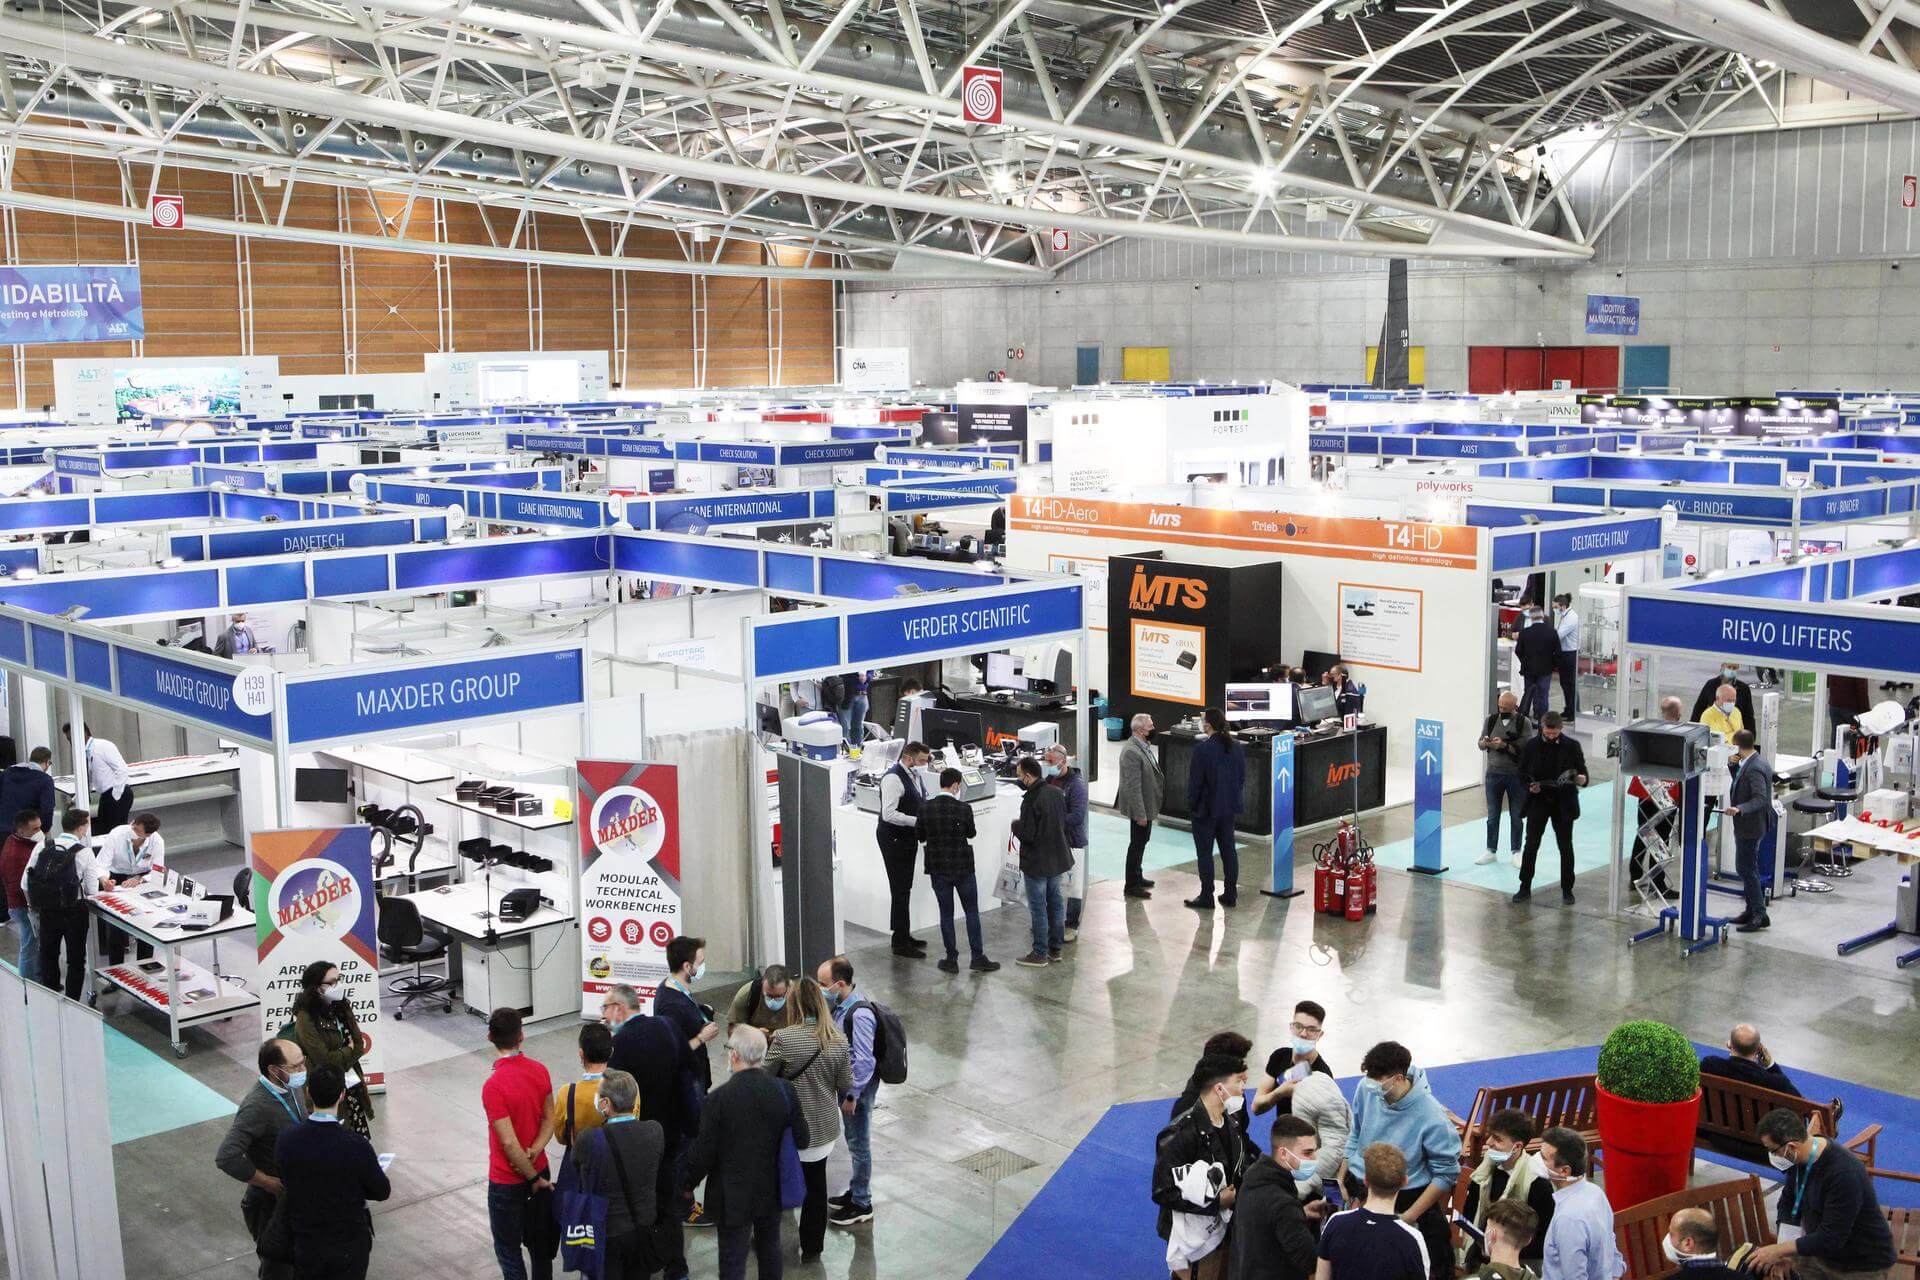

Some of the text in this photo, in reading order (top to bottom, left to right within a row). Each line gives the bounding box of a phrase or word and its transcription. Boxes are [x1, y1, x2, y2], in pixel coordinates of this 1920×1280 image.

[0, 278, 124, 305] IDABILITÀ
[0, 310, 30, 320] esting
[40, 310, 88, 319] Metrologia
[1601, 304, 1626, 314] ADDITIVE
[1588, 314, 1636, 325] MANUFACTURING
[852, 361, 867, 370] CNA
[1213, 424, 1249, 434] FORTEST
[720, 449, 758, 459] CHECK SOLUTION
[805, 447, 854, 459] CHECK SOLUTION
[1417, 481, 1473, 493] polyworks
[518, 502, 584, 520] LEANE INTERNATIONAL
[714, 501, 782, 516] INTERNATIONAL
[1693, 501, 1734, 515] BINDER
[1843, 498, 1859, 511] BINDER
[284, 533, 345, 552] DANETECH
[1571, 530, 1629, 552] DELTATECH ITALY
[1372, 553, 1386, 561] high
[1388, 553, 1417, 563] definition
[1129, 601, 1154, 612] ITALIA
[903, 603, 1030, 641] VERDER SCIENTIFIC
[1722, 618, 1853, 652] RIEVO LIFTERS
[244, 675, 265, 690] H39
[156, 669, 230, 711] MAXDER GROUP
[356, 672, 521, 717] MAXDER GROUP
[247, 692, 265, 705] H41
[1417, 724, 1441, 736] A&T
[1275, 739, 1292, 753] A&T
[597, 807, 658, 845] MAXDER
[599, 873, 658, 886] MODULAR
[596, 887, 663, 900] TECHNICAL
[277, 876, 353, 927] MAXDER
[585, 899, 676, 914] WORKBENCHES
[341, 960, 358, 971] ED
[266, 1006, 293, 1017] PER
